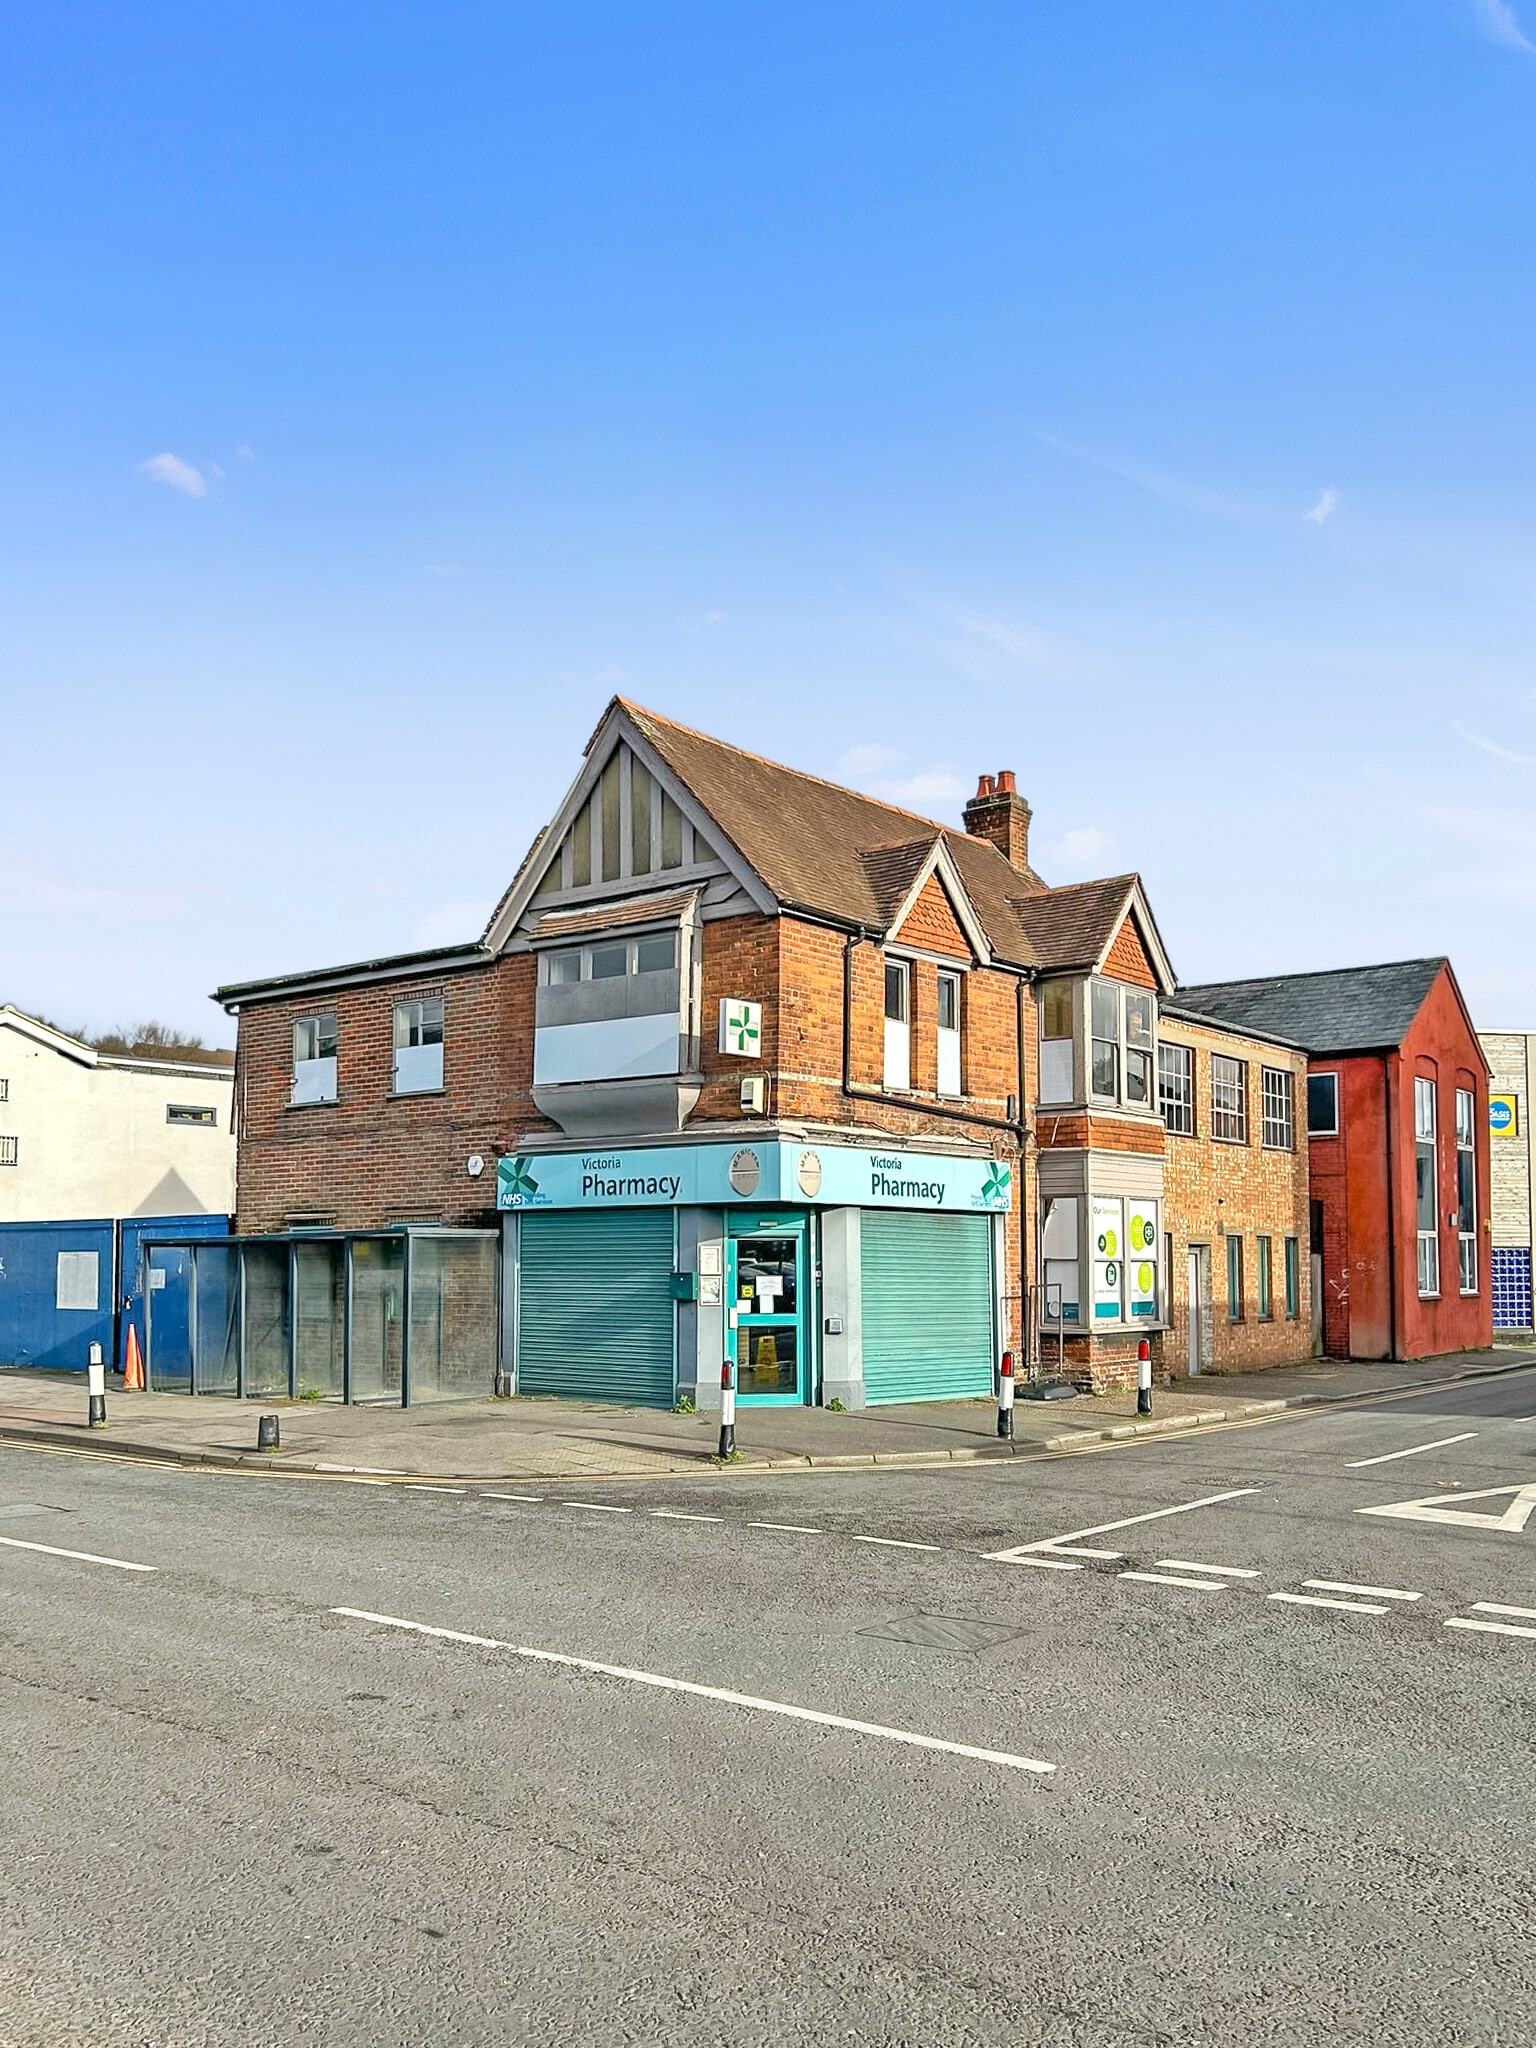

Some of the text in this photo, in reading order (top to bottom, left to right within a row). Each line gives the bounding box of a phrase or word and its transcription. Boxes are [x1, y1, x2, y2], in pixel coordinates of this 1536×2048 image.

[581, 1156, 621, 1170] Victoria
[870, 1155, 902, 1170] Victoria
[582, 1174, 681, 1200] Pharmacy
[871, 1173, 945, 1205] Pharmacy
[502, 1193, 522, 1205] NHS
[994, 1196, 1009, 1208] NHS
[1093, 1206, 1102, 1214] Our
